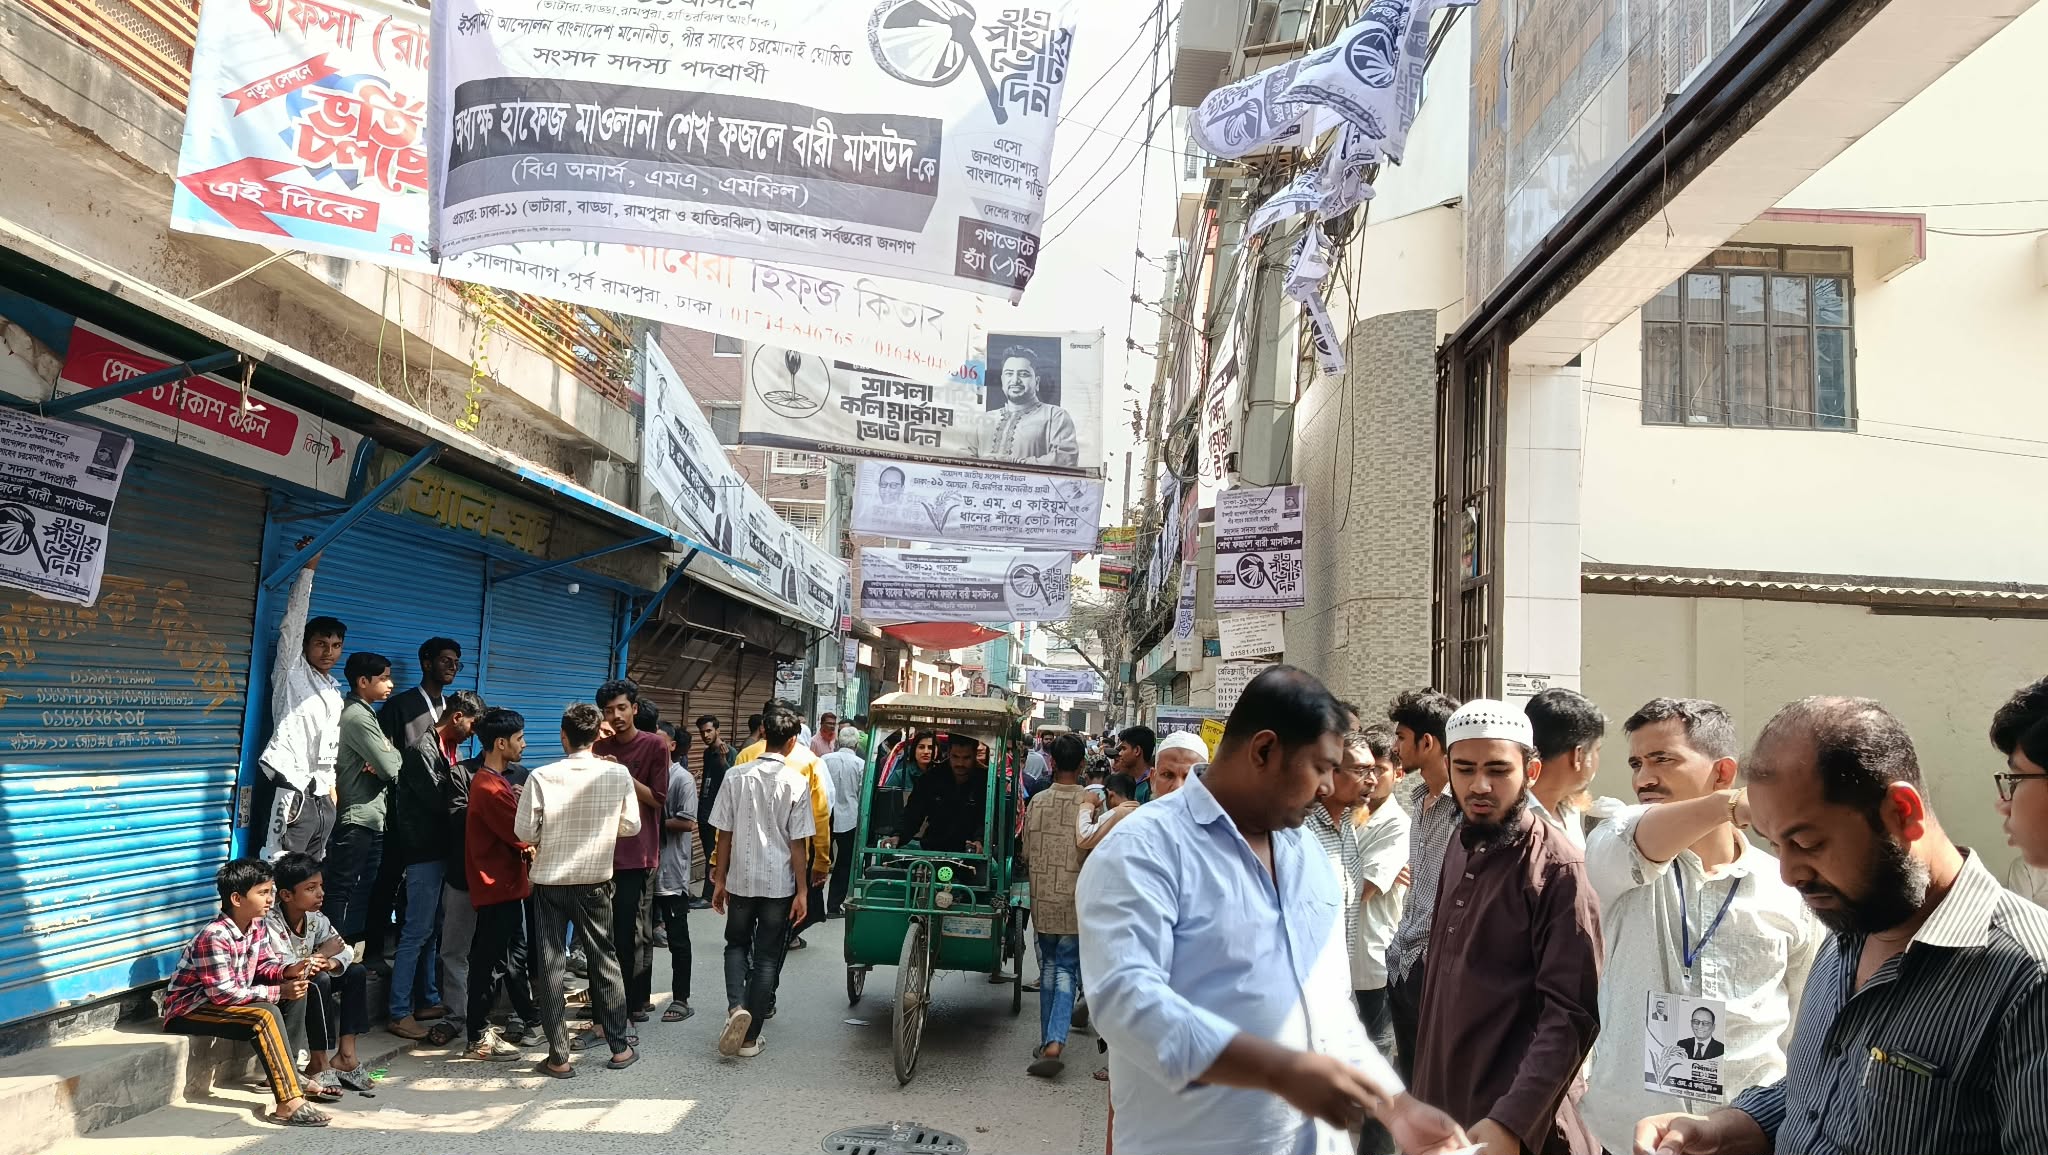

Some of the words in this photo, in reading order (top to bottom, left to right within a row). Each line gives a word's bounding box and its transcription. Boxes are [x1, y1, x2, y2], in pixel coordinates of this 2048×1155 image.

[997, 7, 1051, 32] হাত
[498, 16, 554, 34] আন্দোলন
[556, 20, 613, 40] বাংলাদেশ
[681, 26, 706, 49] পীর
[707, 34, 746, 55] সাহেব
[749, 37, 807, 62] চরমোনাই
[811, 45, 854, 67] ঘোষিত
[533, 47, 600, 69] সংসদ
[607, 53, 671, 75] সদস্য
[989, 47, 1064, 85] ভোট
[244, 78, 273, 101] নতুন
[275, 64, 315, 90] সেশনে
[999, 73, 1051, 117] দিন
[307, 84, 426, 150] ভর্তি
[500, 97, 572, 147] হাফেজ
[576, 101, 664, 151] মাওলানা
[667, 108, 715, 156] শেখ
[718, 116, 788, 163] ফজলে
[792, 116, 839, 169] বারী
[994, 138, 1023, 157] এসো
[511, 156, 558, 186] (বিএ
[718, 174, 809, 208] এমফিল)
[970, 149, 1040, 184] জনপ্রত্যাশার
[965, 165, 1023, 191] বাংলাদেশ
[1025, 178, 1045, 201] গড়ি
[208, 177, 269, 208] এই
[279, 188, 369, 224] দিকে
[983, 204, 1009, 222] দেশের
[479, 201, 518, 221] ঢাকা-১১
[623, 203, 672, 225] রামপুরা
[675, 210, 687, 222] ও
[690, 209, 762, 236] হাতিরঝিল)
[767, 219, 818, 241] আসনের
[821, 225, 873, 250] সর্বস্তরের
[876, 236, 917, 255] জনগণ
[974, 227, 1036, 256] গণভোটে
[674, 294, 713, 316] ঢাকা
[170, 381, 228, 425] বিকাশ
[861, 375, 934, 403] শাপলা
[840, 392, 884, 419] কলি
[889, 396, 955, 428] মার্কায়
[33, 426, 70, 443] আসনে
[856, 420, 900, 441] ভোট
[903, 423, 944, 448] দিন
[7, 463, 37, 478] সদস্য
[27, 486, 53, 505] বারী
[963, 495, 977, 509] ড.
[983, 497, 1006, 510] এম.
[1011, 499, 1022, 510] এ
[1026, 496, 1069, 514] কাইয়ুম
[960, 511, 992, 523] ধানের
[995, 510, 1022, 526] শীষে
[1025, 514, 1050, 526] ভোট
[1054, 514, 1078, 528] দিয়ে
